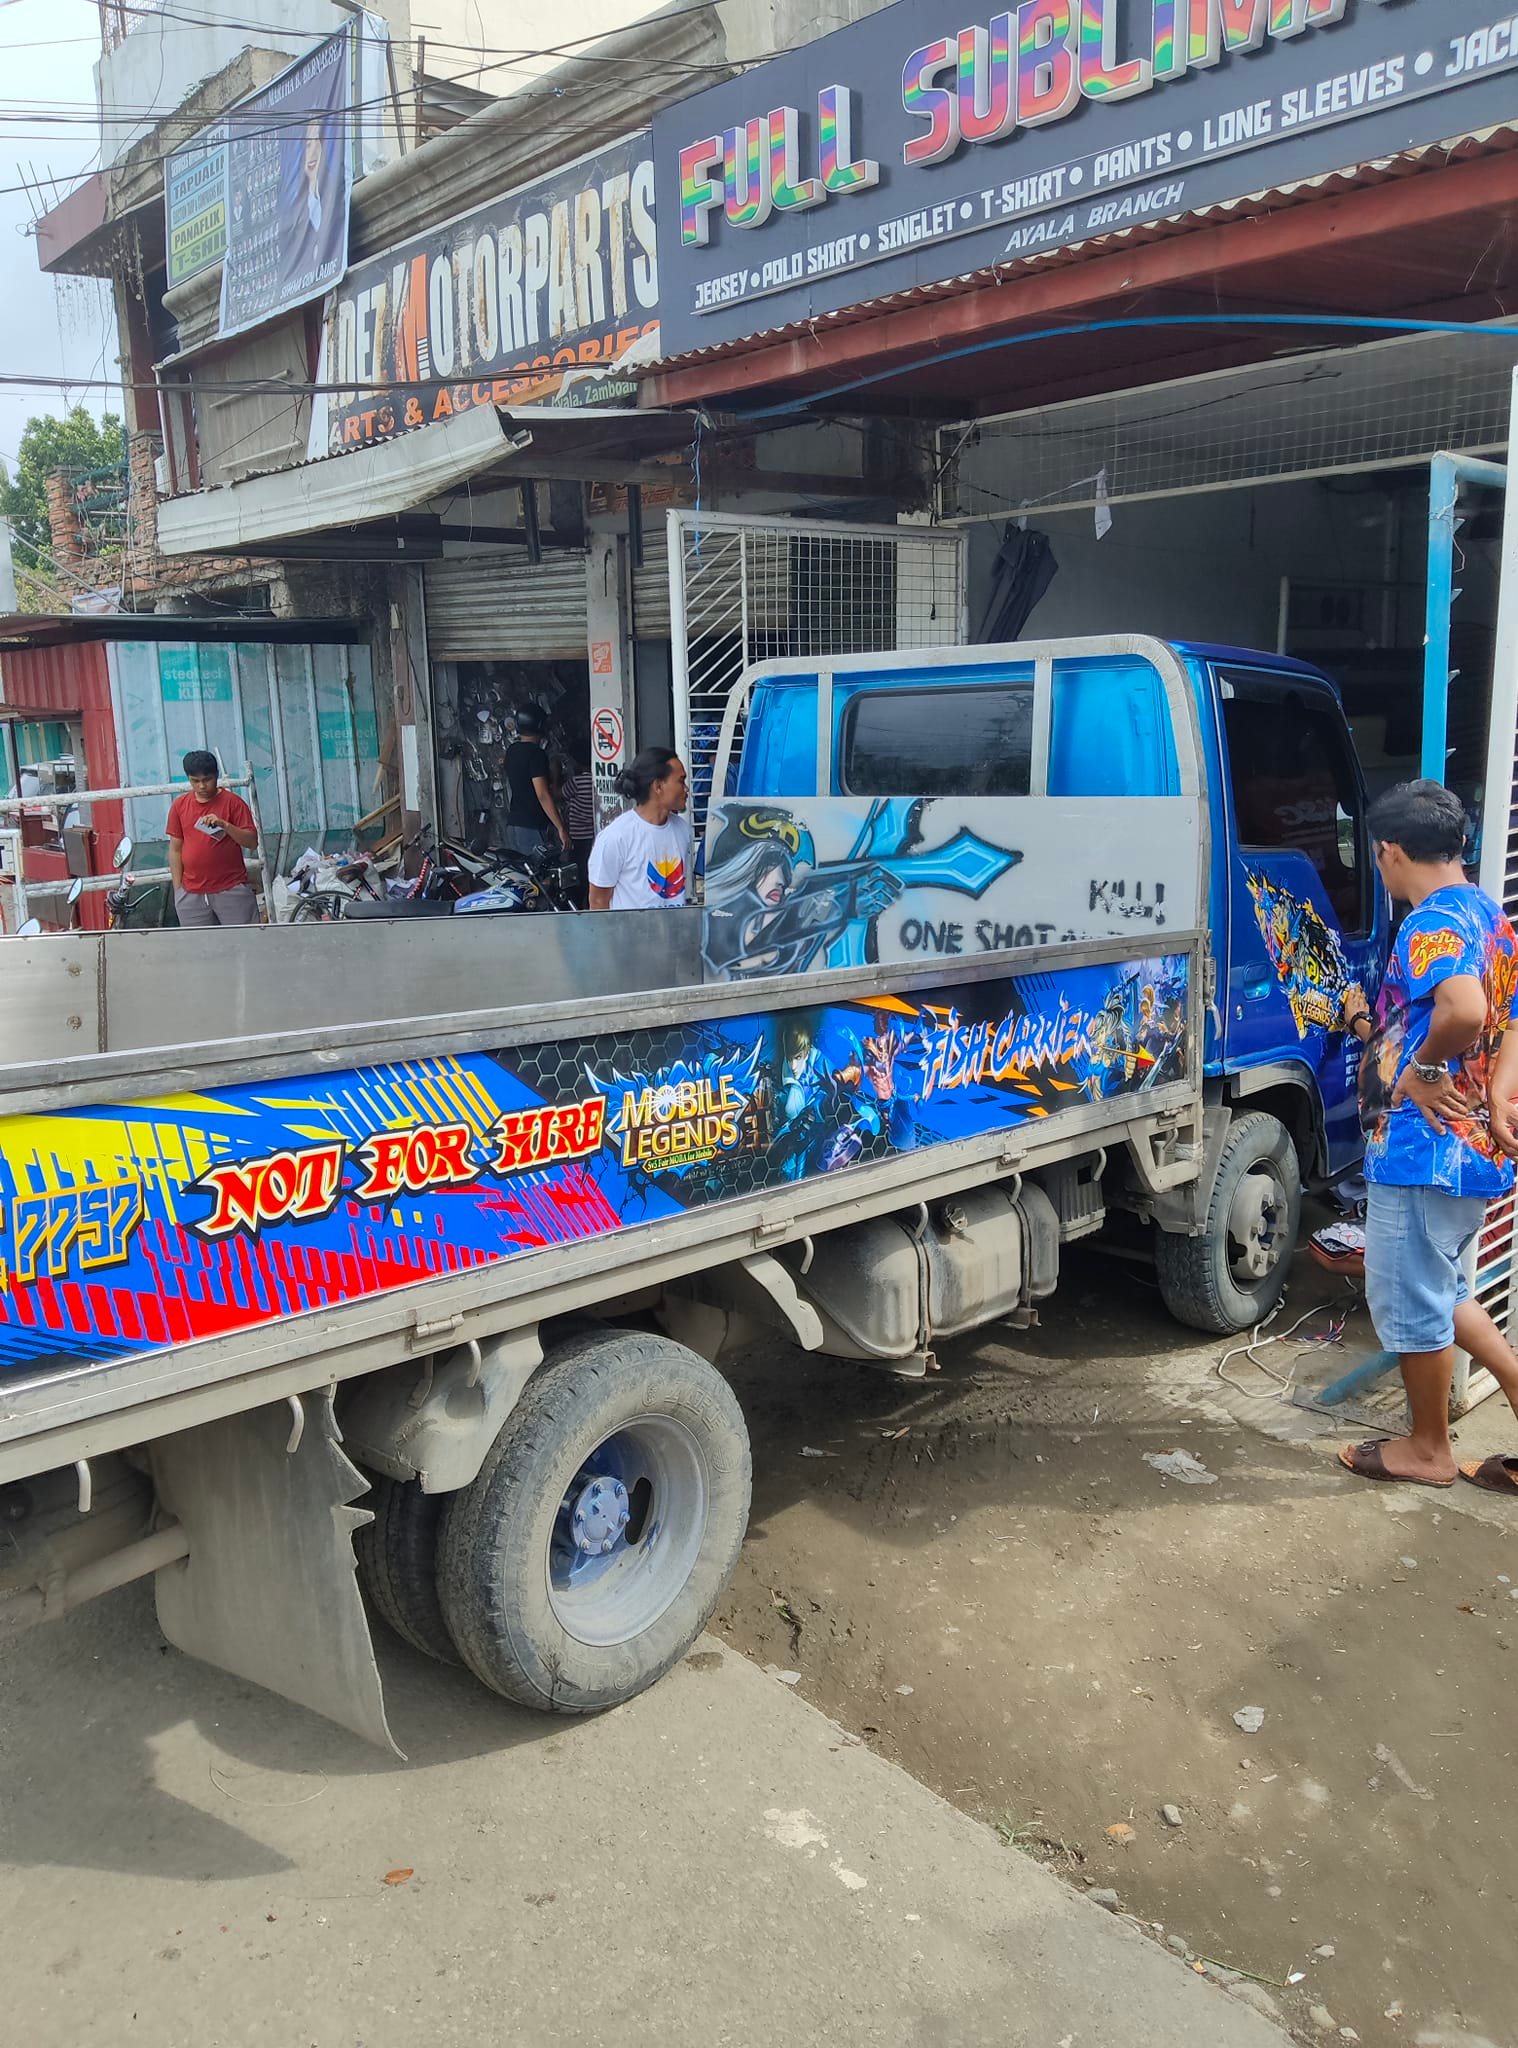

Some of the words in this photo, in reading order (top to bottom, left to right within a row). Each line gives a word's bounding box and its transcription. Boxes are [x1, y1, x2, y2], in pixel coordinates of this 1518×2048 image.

[679, 84, 879, 248] FULL
[902, 0, 1385, 166] SUBLI
[695, 269, 748, 309] JERSEY
[762, 252, 803, 288] POLO
[807, 234, 857, 274] SHIRT
[877, 202, 956, 252] SINGLET
[980, 167, 1066, 219] T-SHIRT
[1093, 132, 1172, 187] PANTS
[1203, 105, 1272, 152] LONG
[1281, 56, 1405, 125] SLEEVES
[1004, 214, 1075, 252] AYALA
[1086, 181, 1185, 229] BRANCH
[403, 395, 424, 428] &
[595, 762, 618, 777] NO
[900, 918, 963, 954] ONE
[975, 919, 1056, 952] SHOT
[1410, 931, 1464, 963] Cactus
[1414, 944, 1458, 977] Jack
[921, 1004, 990, 1102] FISH
[992, 990, 1094, 1078] CARRIER
[615, 1073, 742, 1132] MOBILE
[194, 1142, 345, 1236] NOT
[354, 1124, 481, 1200] FOR
[492, 1096, 607, 1174] HIRE
[622, 1111, 739, 1167] LEGENDS
